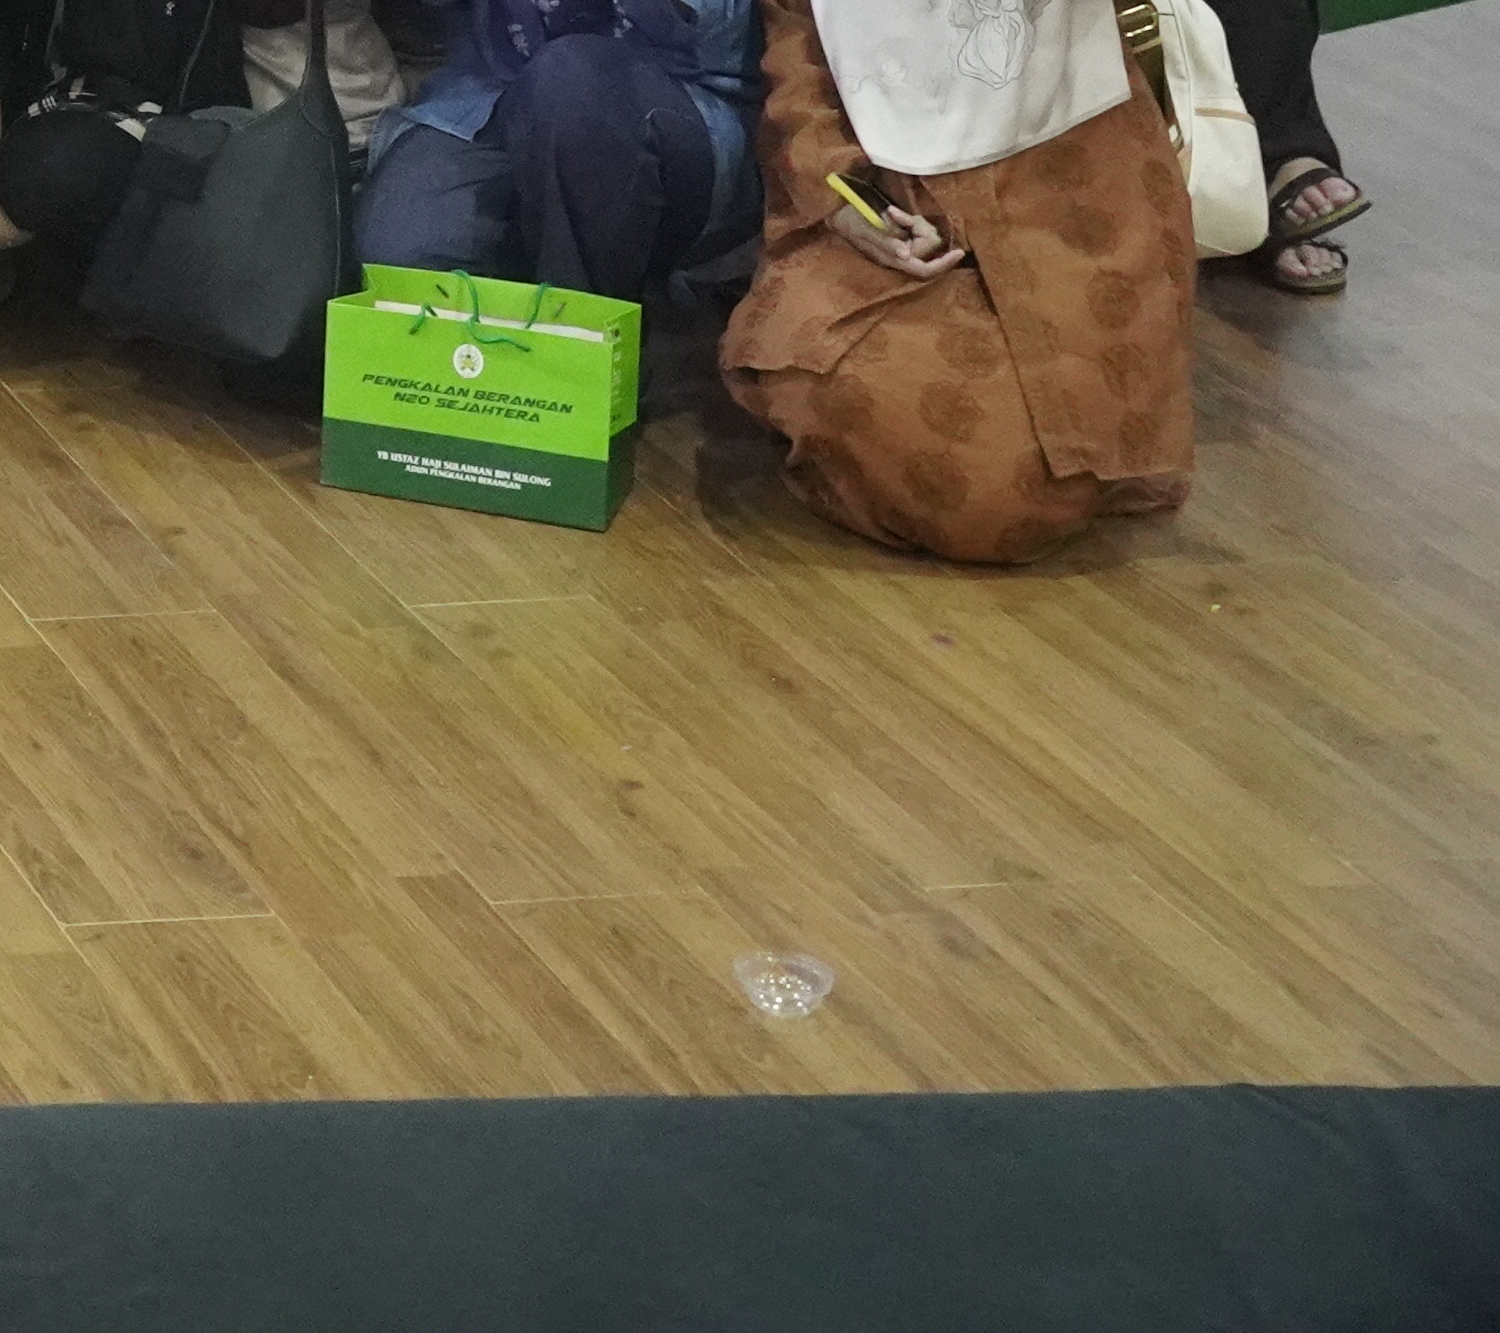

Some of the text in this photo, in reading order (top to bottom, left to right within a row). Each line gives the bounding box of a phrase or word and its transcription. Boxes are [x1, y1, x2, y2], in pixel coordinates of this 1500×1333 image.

[361, 373, 573, 413] PENGKALAN BERANGAN
[434, 397, 540, 423] SEJAHTERA
